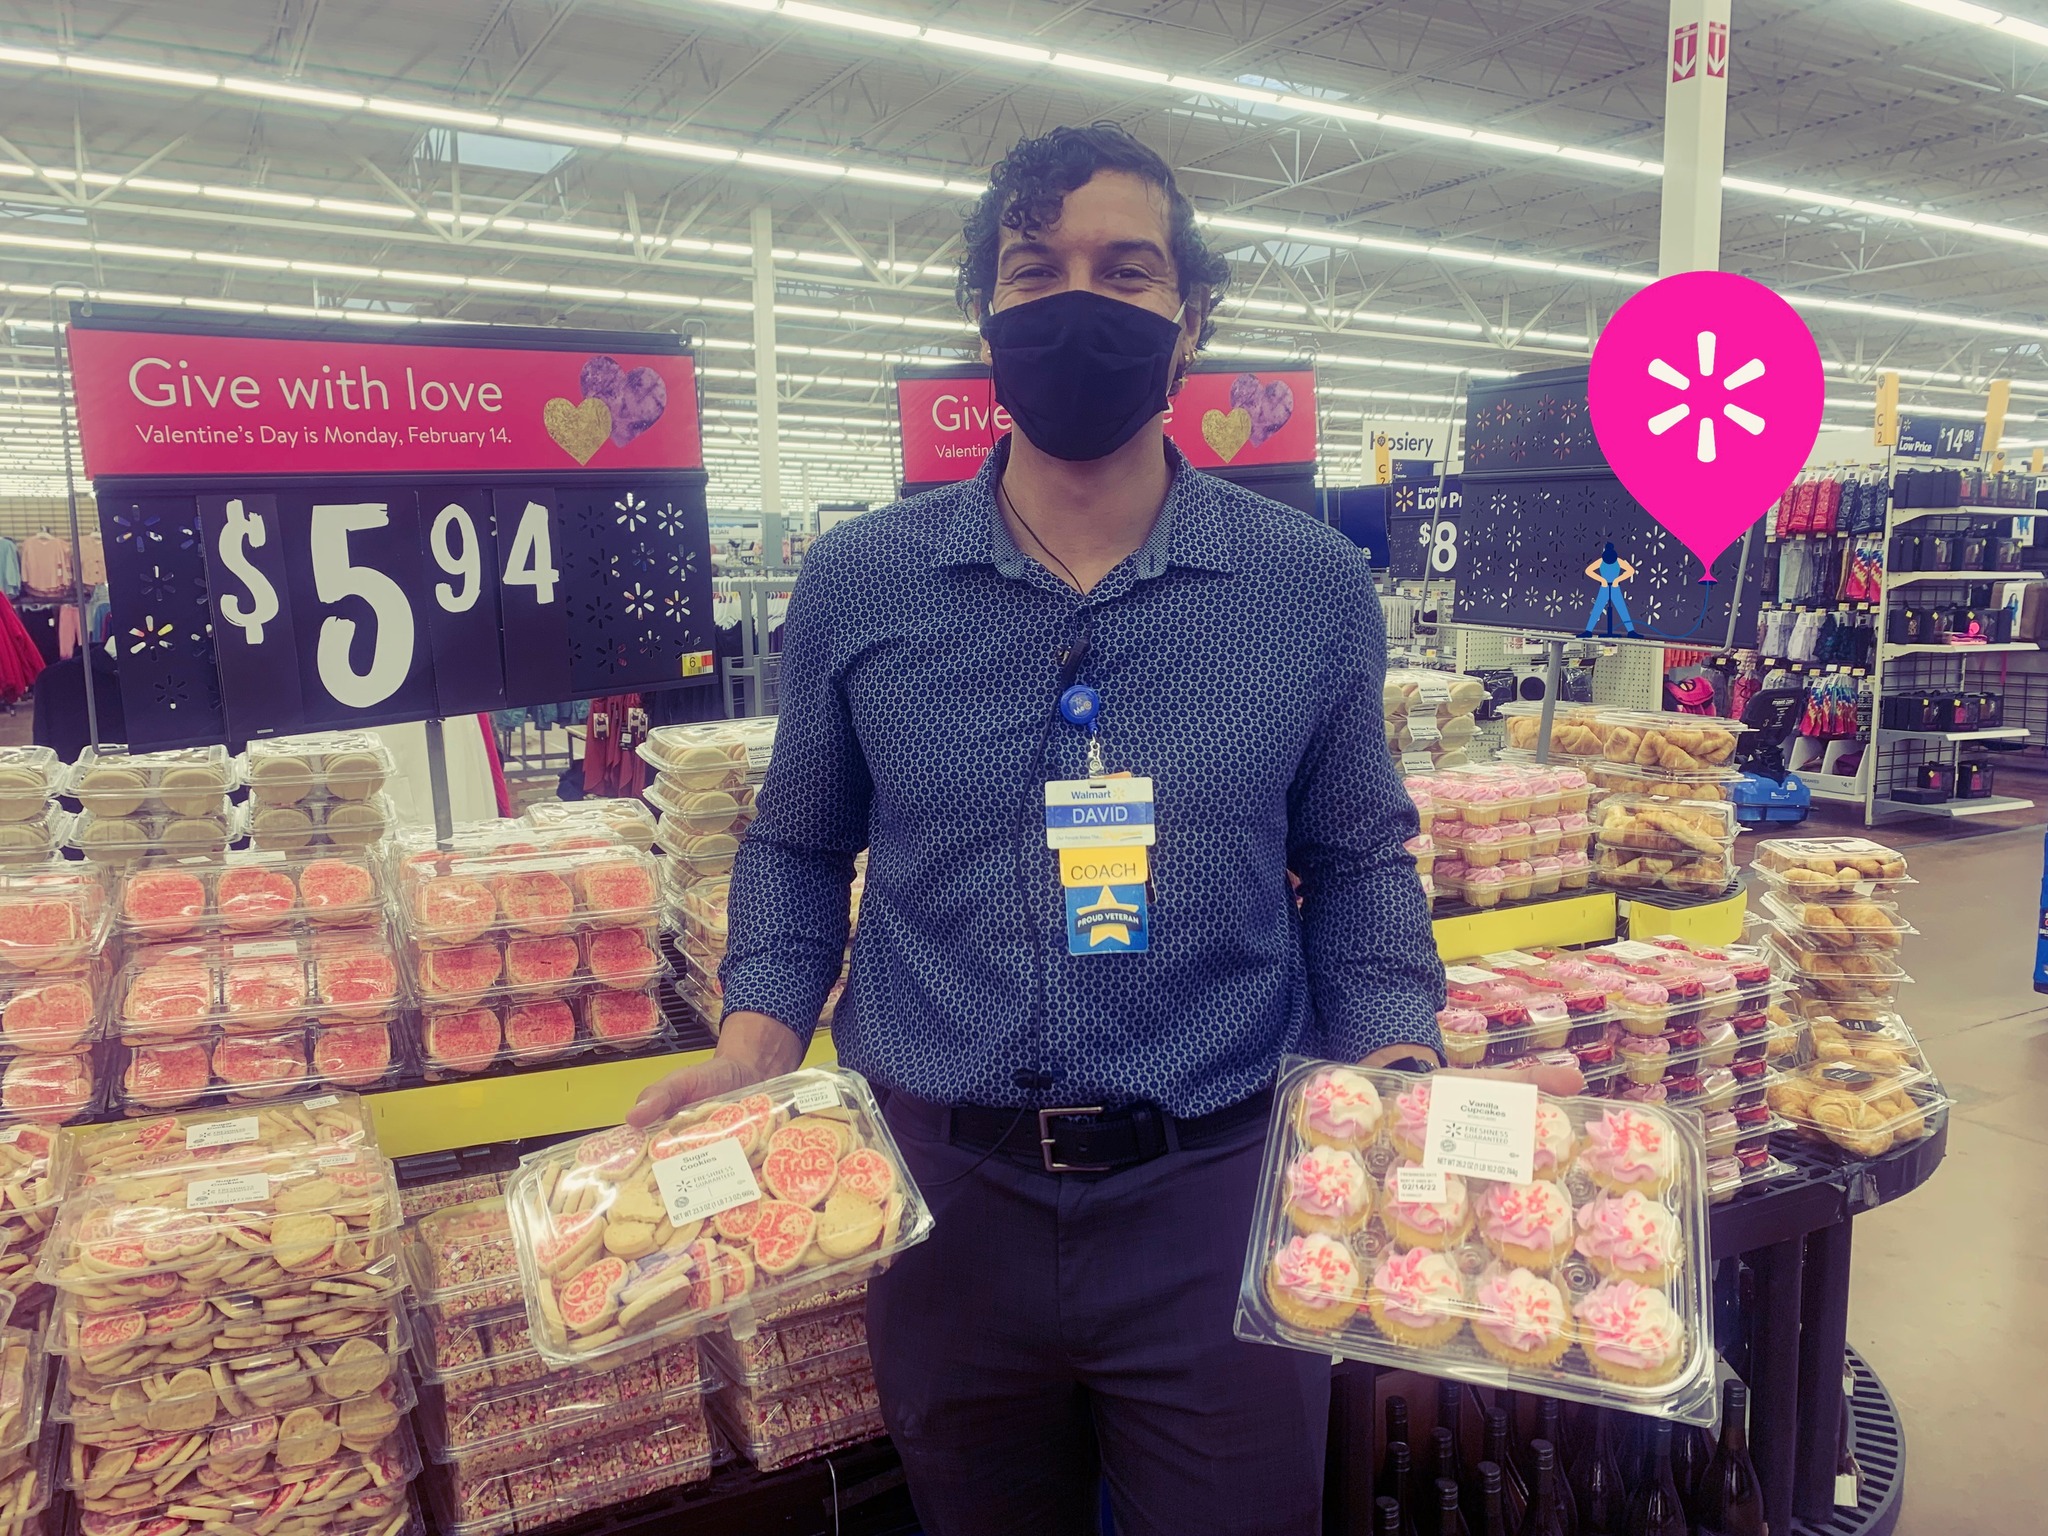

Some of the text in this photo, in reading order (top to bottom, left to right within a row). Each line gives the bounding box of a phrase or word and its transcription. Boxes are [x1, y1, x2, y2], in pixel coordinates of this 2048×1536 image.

[128, 357, 503, 413] Give with love
[931, 394, 1012, 432] Give
[1876, 413, 1884, 426] C
[259, 425, 299, 448] Day
[304, 426, 318, 444] is
[323, 425, 404, 449] Monday,
[408, 426, 486, 448] February
[489, 427, 512, 444] 14.
[1876, 431, 1882, 443] 2
[935, 444, 995, 459] Valentin
[1900, 441, 1933, 452] Low Price
[1378, 464, 1387, 474] C
[689, 656, 696, 668] 6
[1071, 790, 1111, 800] Walmart
[1072, 806, 1128, 824] DAVID
[1070, 862, 1136, 880] COACH
[1078, 912, 1139, 928] PROUD VETERAN
[1460, 1104, 1506, 1118] Cupcakes
[1468, 1100, 1499, 1110] Vanilla
[1464, 1126, 1509, 1138] FRESHNESS
[1464, 1134, 1508, 1144] GUARANTEED
[680, 1156, 718, 1172] Cookies
[682, 1150, 710, 1164] Sugar
[778, 1155, 828, 1173] True
[1437, 1157, 1446, 1165] NET
[693, 1166, 734, 1183] FRESHNESS
[694, 1172, 736, 1188] GUARANTEED
[672, 1212, 684, 1222] NET
